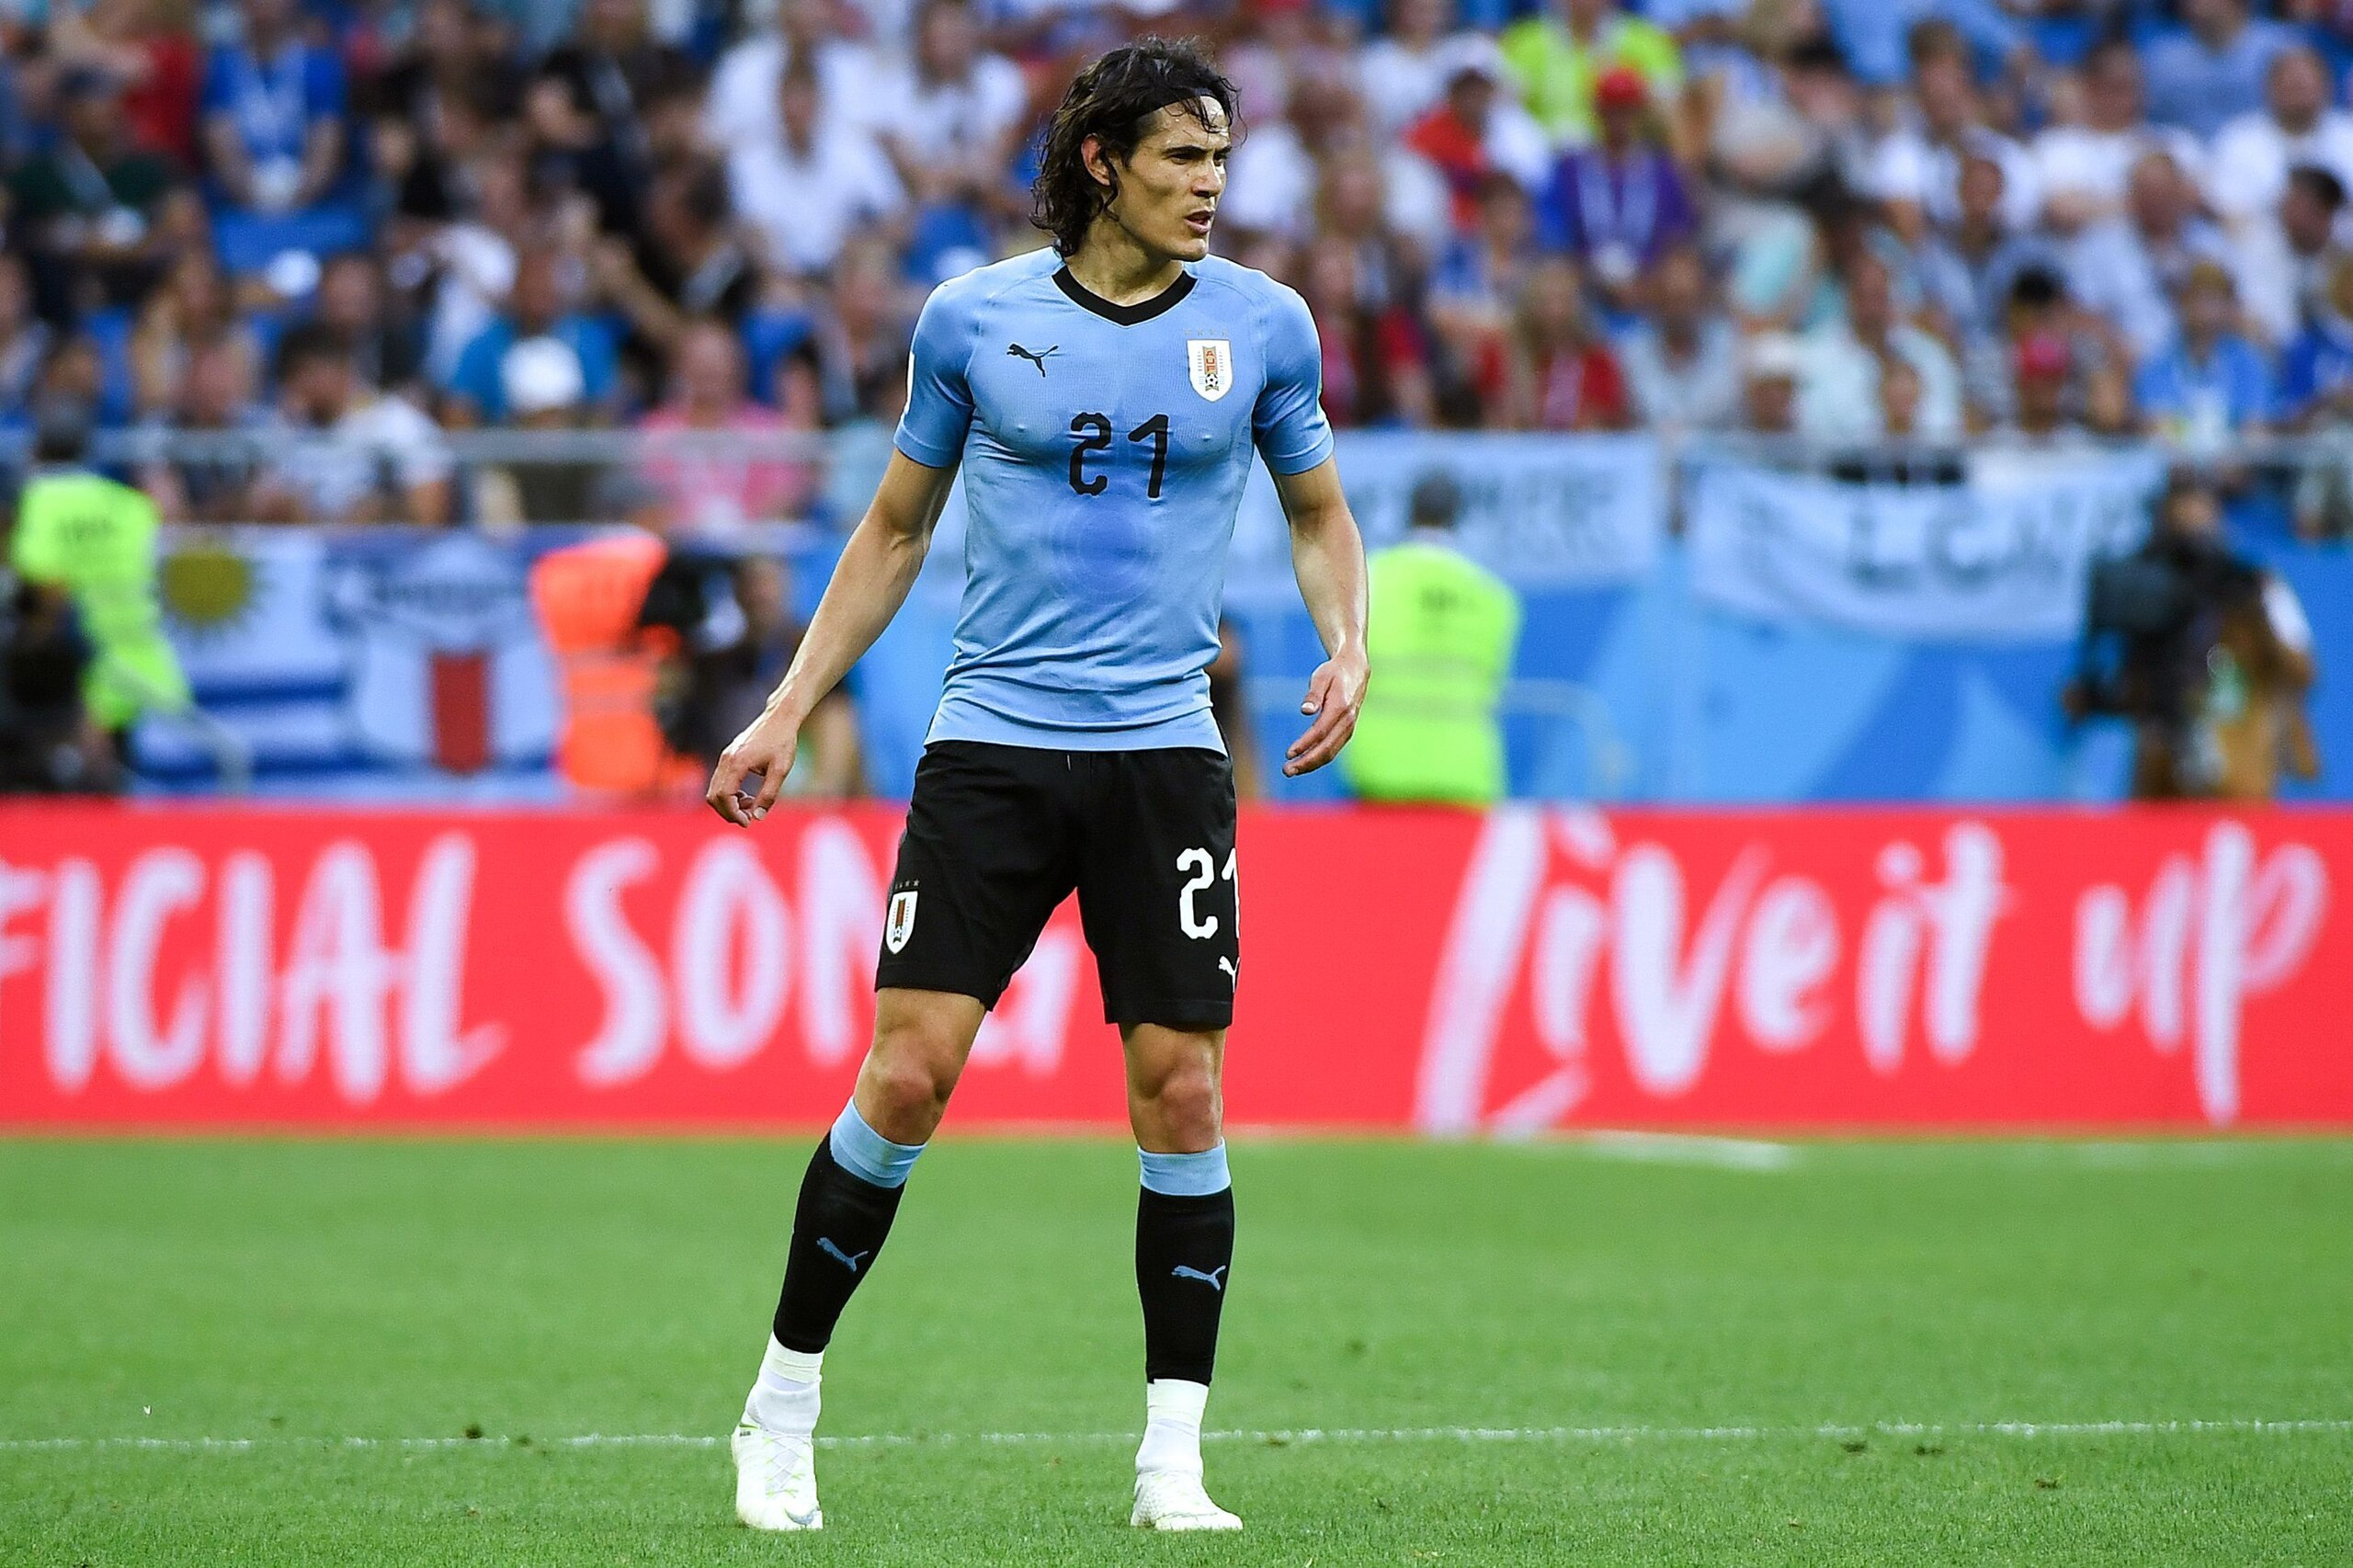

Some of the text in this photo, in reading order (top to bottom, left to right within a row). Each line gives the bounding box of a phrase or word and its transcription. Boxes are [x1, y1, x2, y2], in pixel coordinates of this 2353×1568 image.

[1206, 350, 1215, 372] AUF
[1069, 412, 1169, 498] 21
[1176, 847, 1239, 938] 21
[1412, 798, 2331, 1142] Live it up
